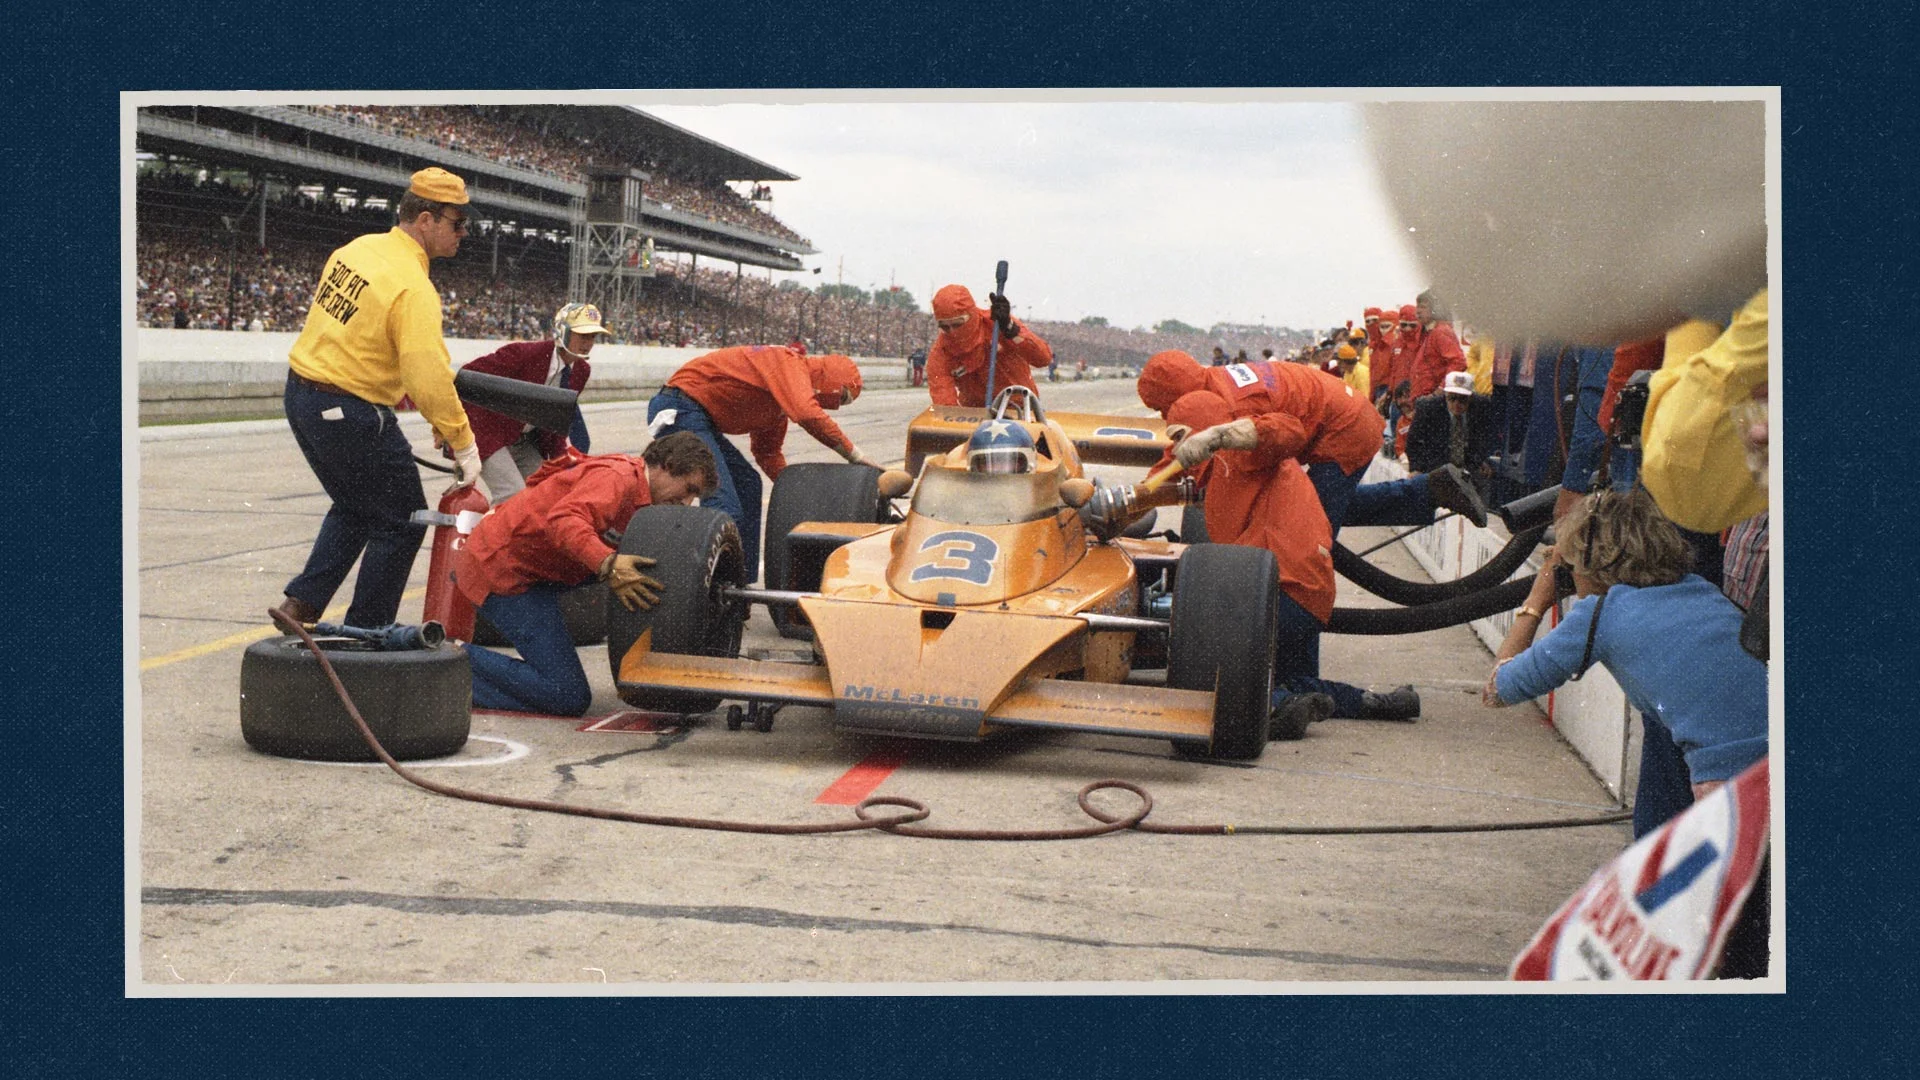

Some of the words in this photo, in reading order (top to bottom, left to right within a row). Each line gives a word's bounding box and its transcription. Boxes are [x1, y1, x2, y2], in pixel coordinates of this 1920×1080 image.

[328, 260, 352, 289] 500
[343, 274, 370, 301] PIT
[325, 292, 359, 325] CREW
[909, 530, 999, 588] 3
[844, 684, 980, 709] McLaren
